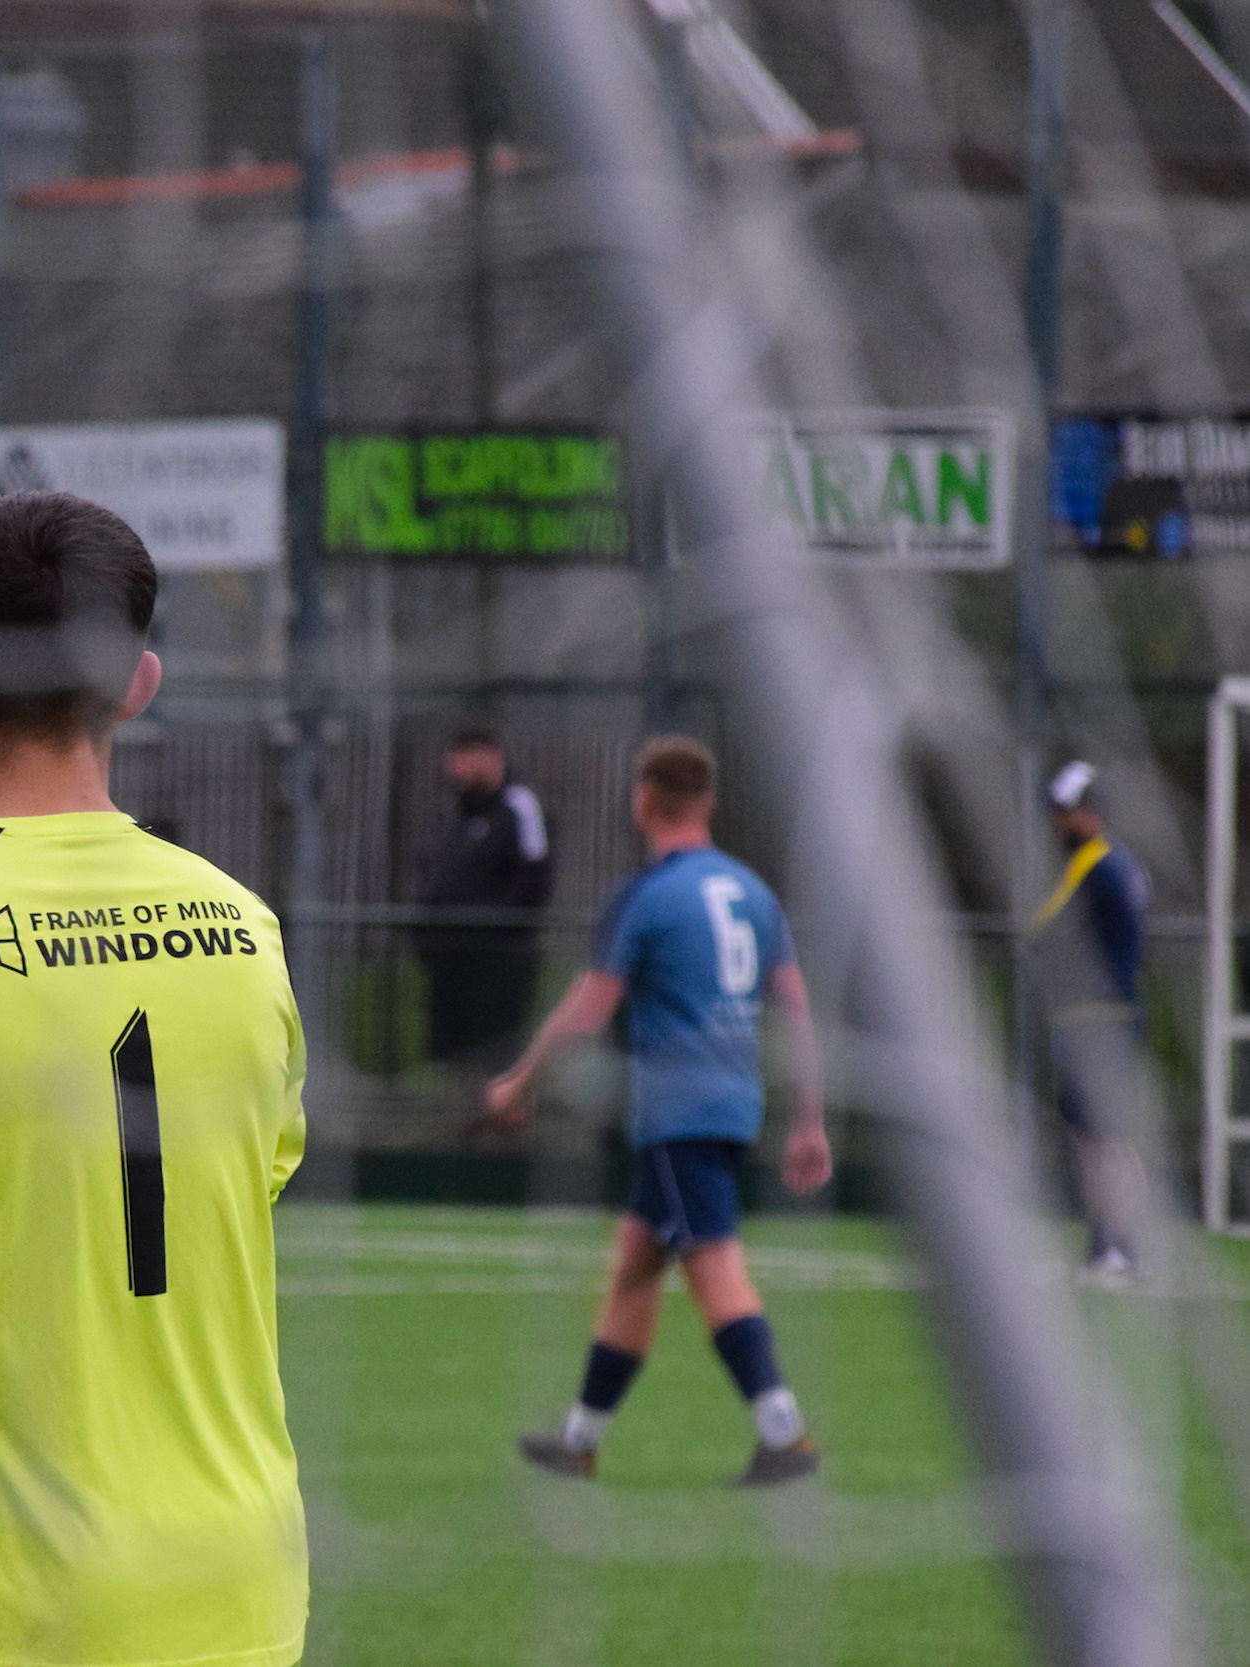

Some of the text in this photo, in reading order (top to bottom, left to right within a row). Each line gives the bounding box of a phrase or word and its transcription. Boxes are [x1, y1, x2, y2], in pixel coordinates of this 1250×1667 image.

[29, 901, 242, 931] FRAME OF MIND
[35, 928, 257, 967] WINDOWS
[701, 875, 758, 996] 6
[110, 1006, 167, 1297] 1
